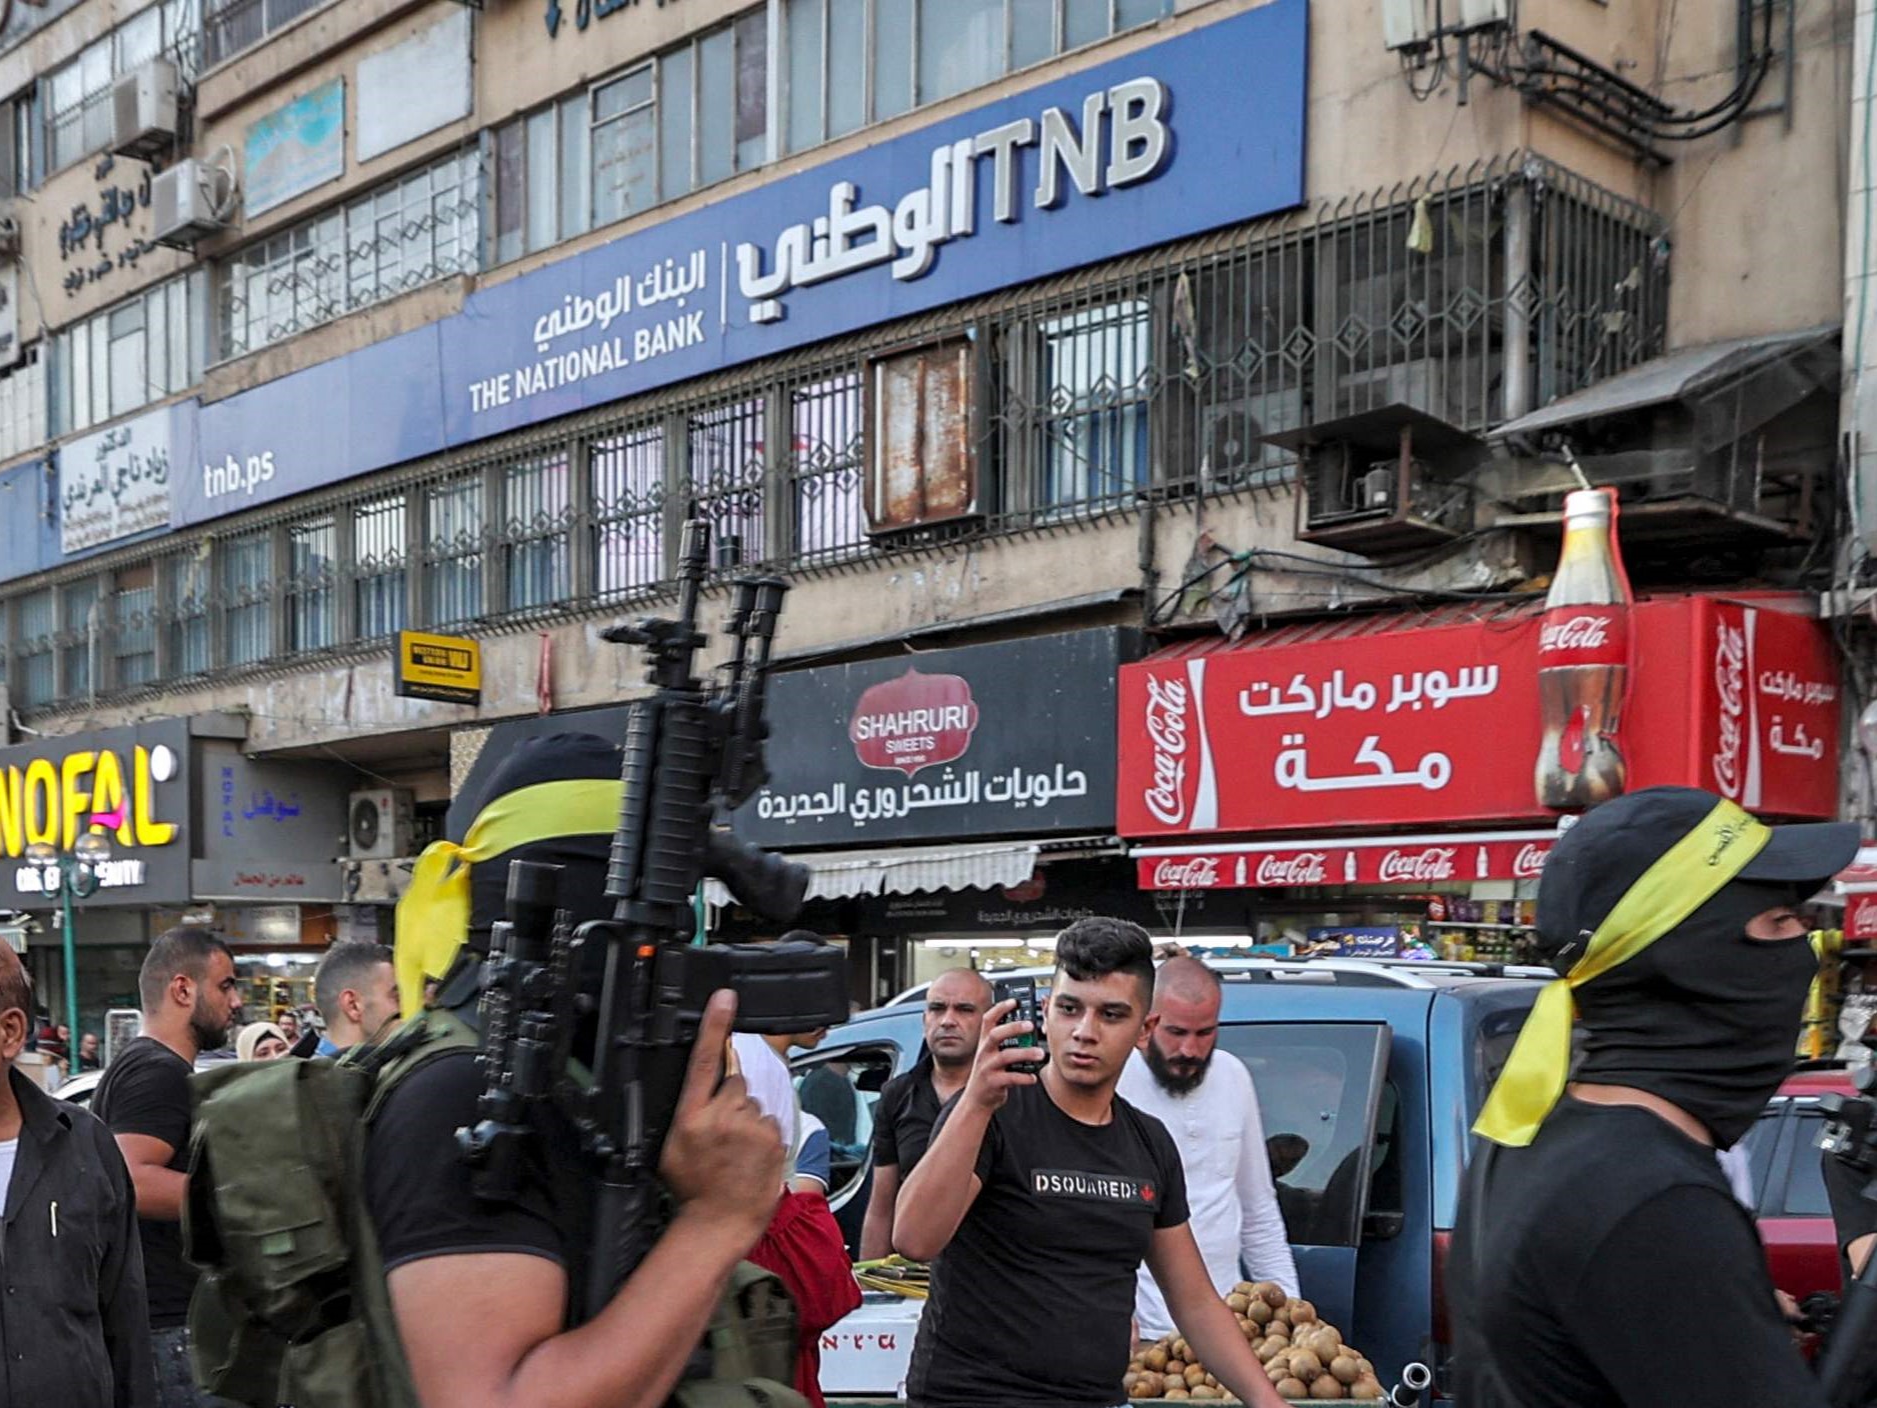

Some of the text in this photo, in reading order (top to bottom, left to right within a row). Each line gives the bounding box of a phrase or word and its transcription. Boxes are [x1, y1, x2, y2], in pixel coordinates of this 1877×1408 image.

[975, 76, 1175, 223] TNB
[736, 137, 975, 325] الوطني
[533, 249, 706, 353] البنك الوطني
[469, 310, 705, 413] THE NATIONAL BANK
[203, 451, 275, 499] tnb.ps
[1238, 664, 1500, 719] سوبر ماركت
[856, 705, 969, 740] SHAHRURI
[885, 735, 935, 754] SWEETS
[1145, 672, 1186, 826] Coca-Cola
[1769, 714, 1824, 760] مكة
[1273, 733, 1453, 793] مكة
[757, 763, 1087, 827] حلويات الشحروري الجديدة
[1154, 857, 1220, 888] Coca-Cola
[1257, 853, 1327, 886] Coca-Cola
[1379, 847, 1457, 882] Coca-Cola
